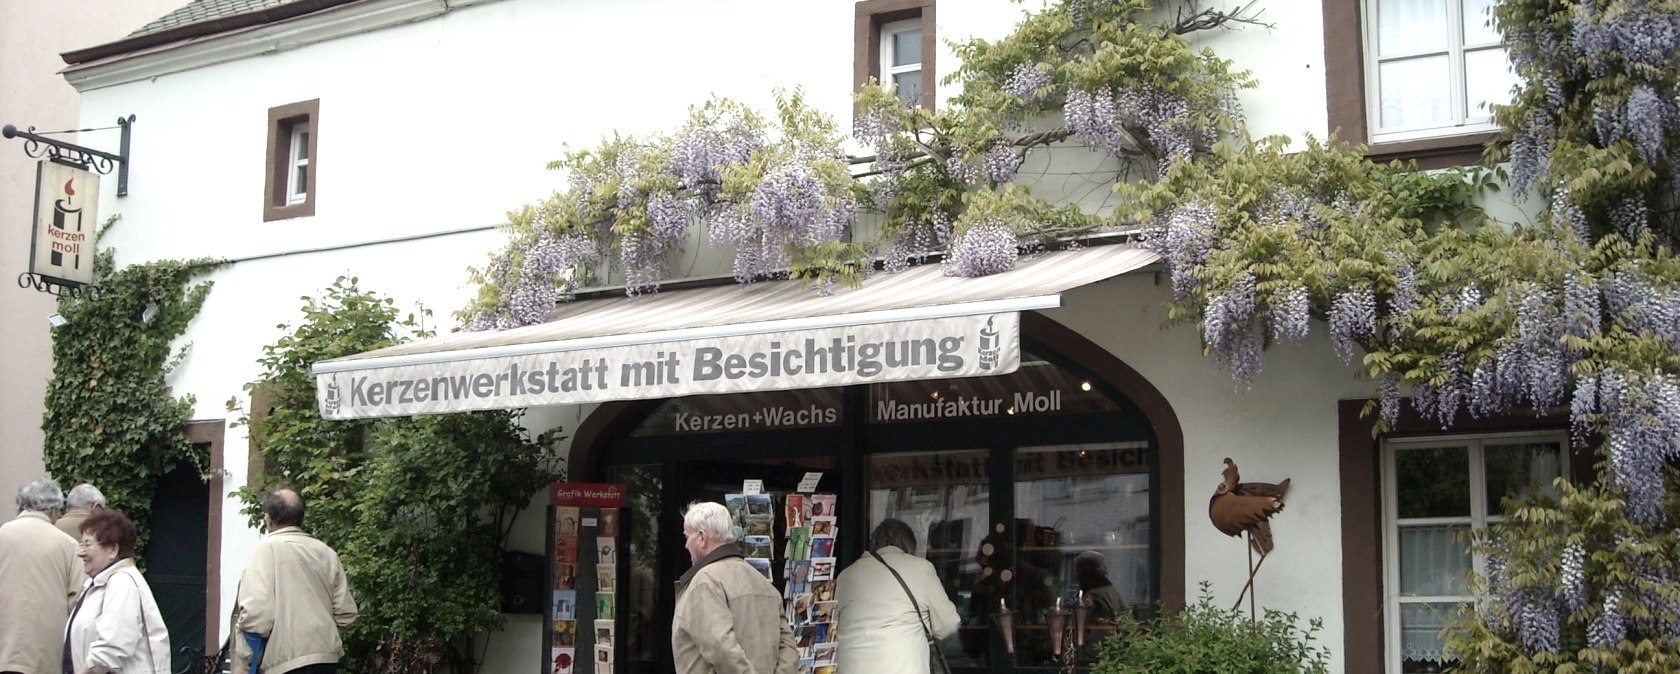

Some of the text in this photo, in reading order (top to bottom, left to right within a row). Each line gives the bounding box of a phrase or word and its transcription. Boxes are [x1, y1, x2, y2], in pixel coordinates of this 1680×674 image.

[48, 224, 85, 241] kerzen
[52, 241, 80, 253] moll
[351, 335, 965, 407] Kerzenwerkstatt mit Besichtigung
[675, 390, 1061, 432] Kerzen+Wachs Manufaktur Moll
[557, 489, 620, 499] Grafik Werkstatt
